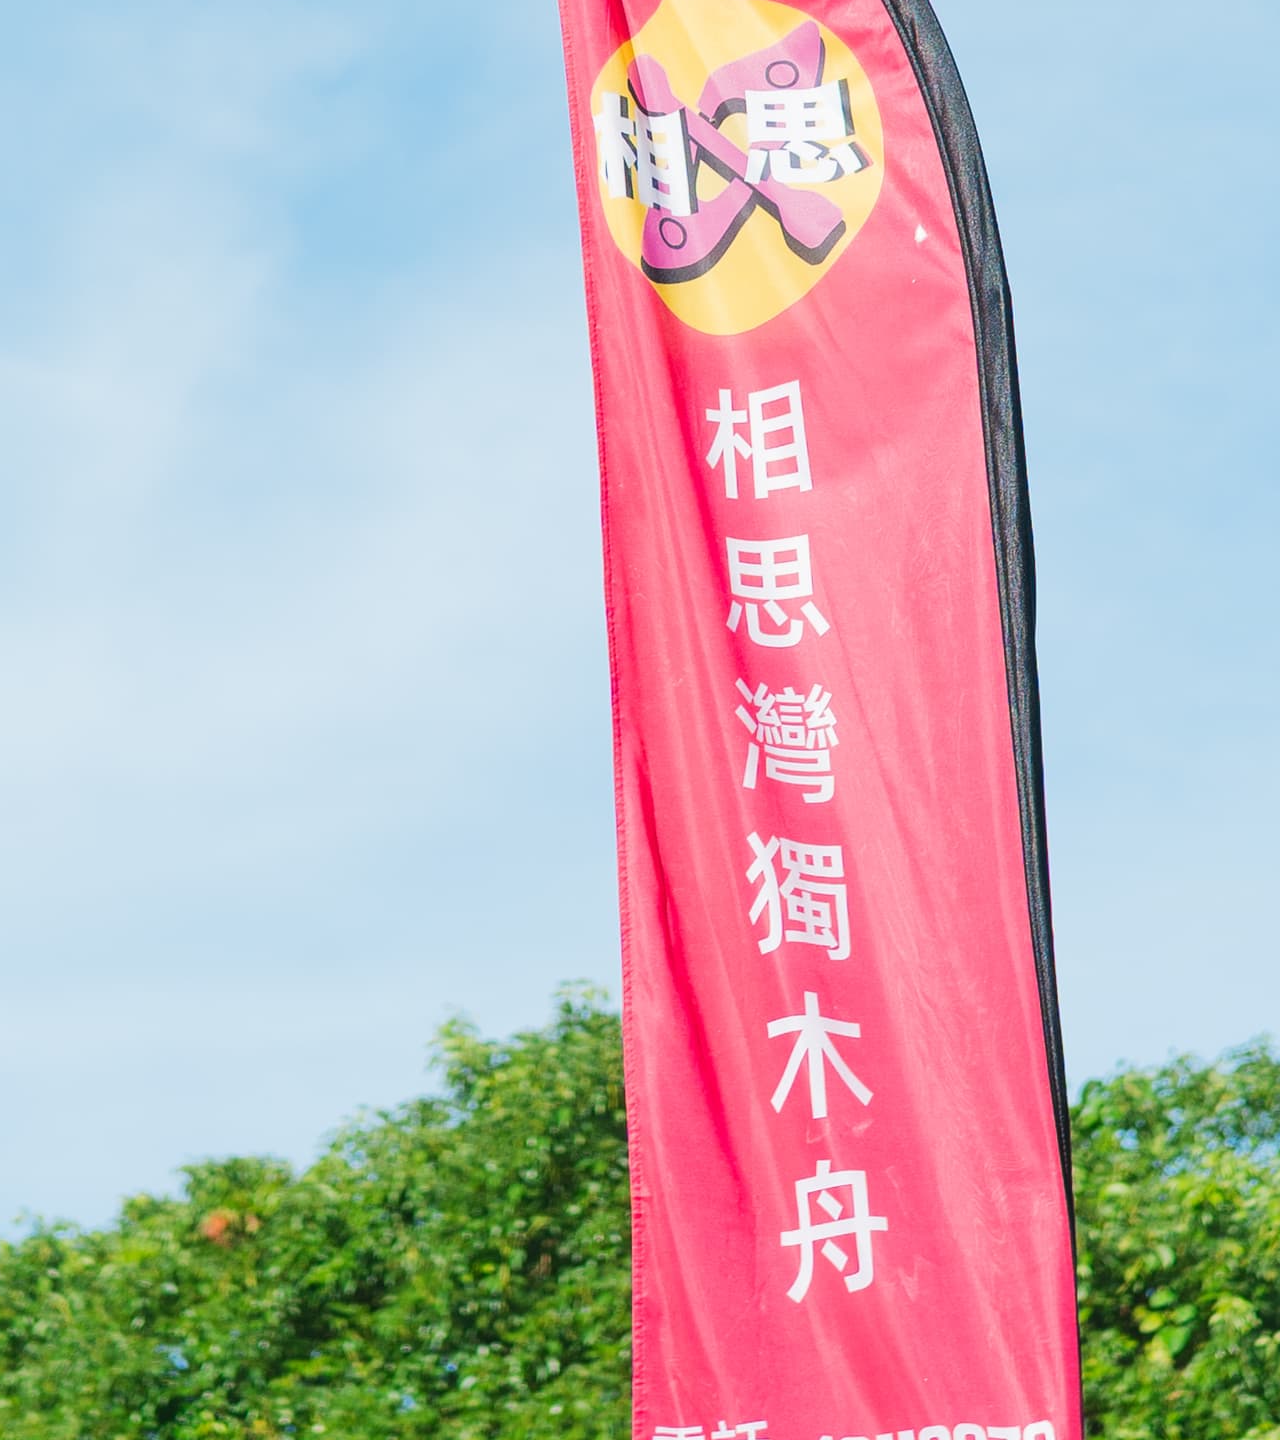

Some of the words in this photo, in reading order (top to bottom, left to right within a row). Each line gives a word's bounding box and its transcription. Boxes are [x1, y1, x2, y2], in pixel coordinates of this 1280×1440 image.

[592, 77, 872, 217] 相思
[704, 377, 889, 1304] 相思灣獨木舟
